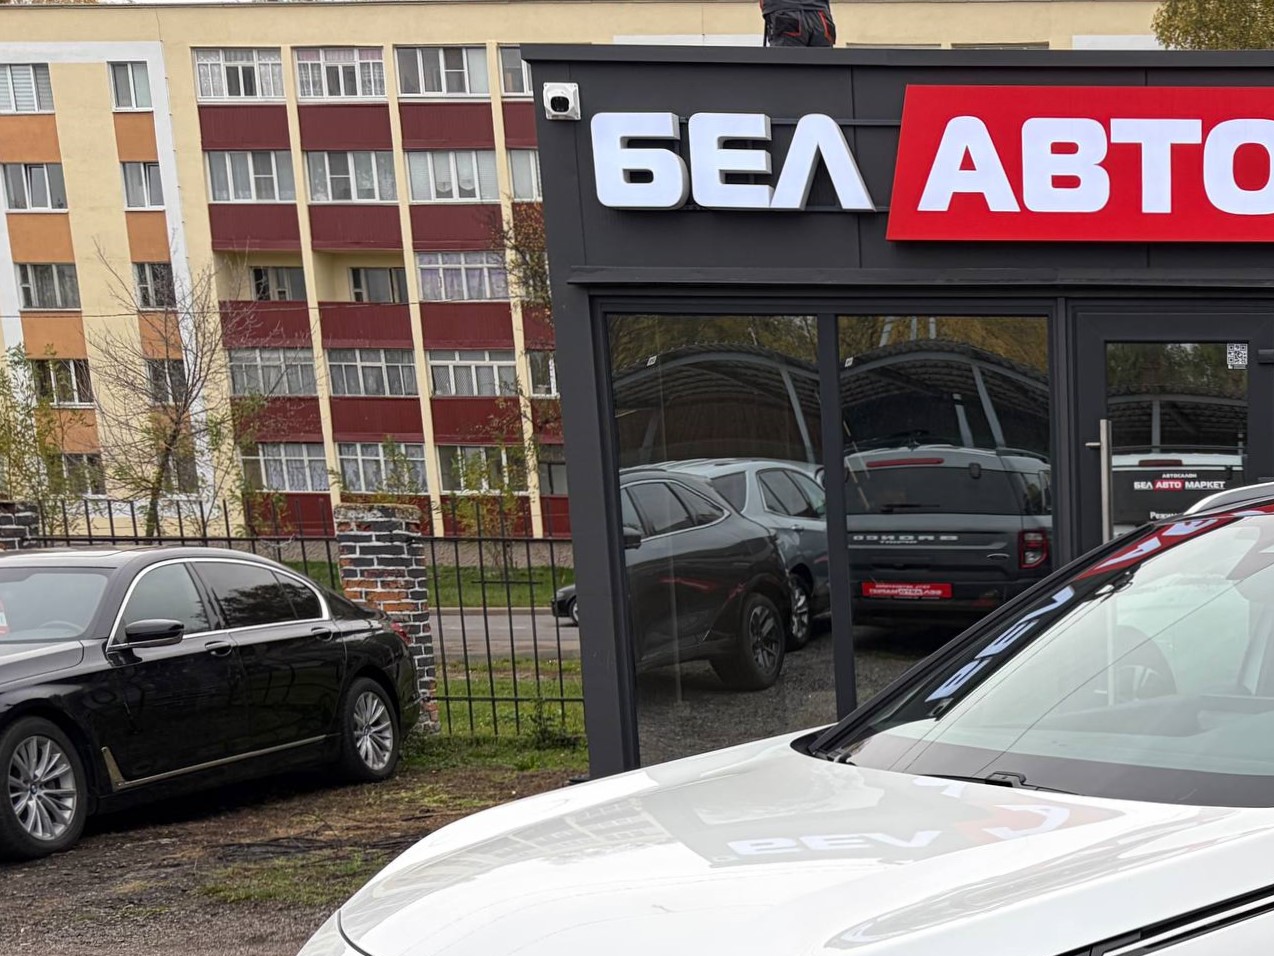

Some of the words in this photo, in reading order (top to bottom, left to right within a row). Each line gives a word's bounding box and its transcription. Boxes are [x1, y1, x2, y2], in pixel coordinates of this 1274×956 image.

[591, 112, 876, 213] БЕЛ
[1133, 481, 1153, 489] БЕЛ
[1155, 481, 1182, 489] АВТО
[1184, 481, 1226, 489] МАРКЕТ
